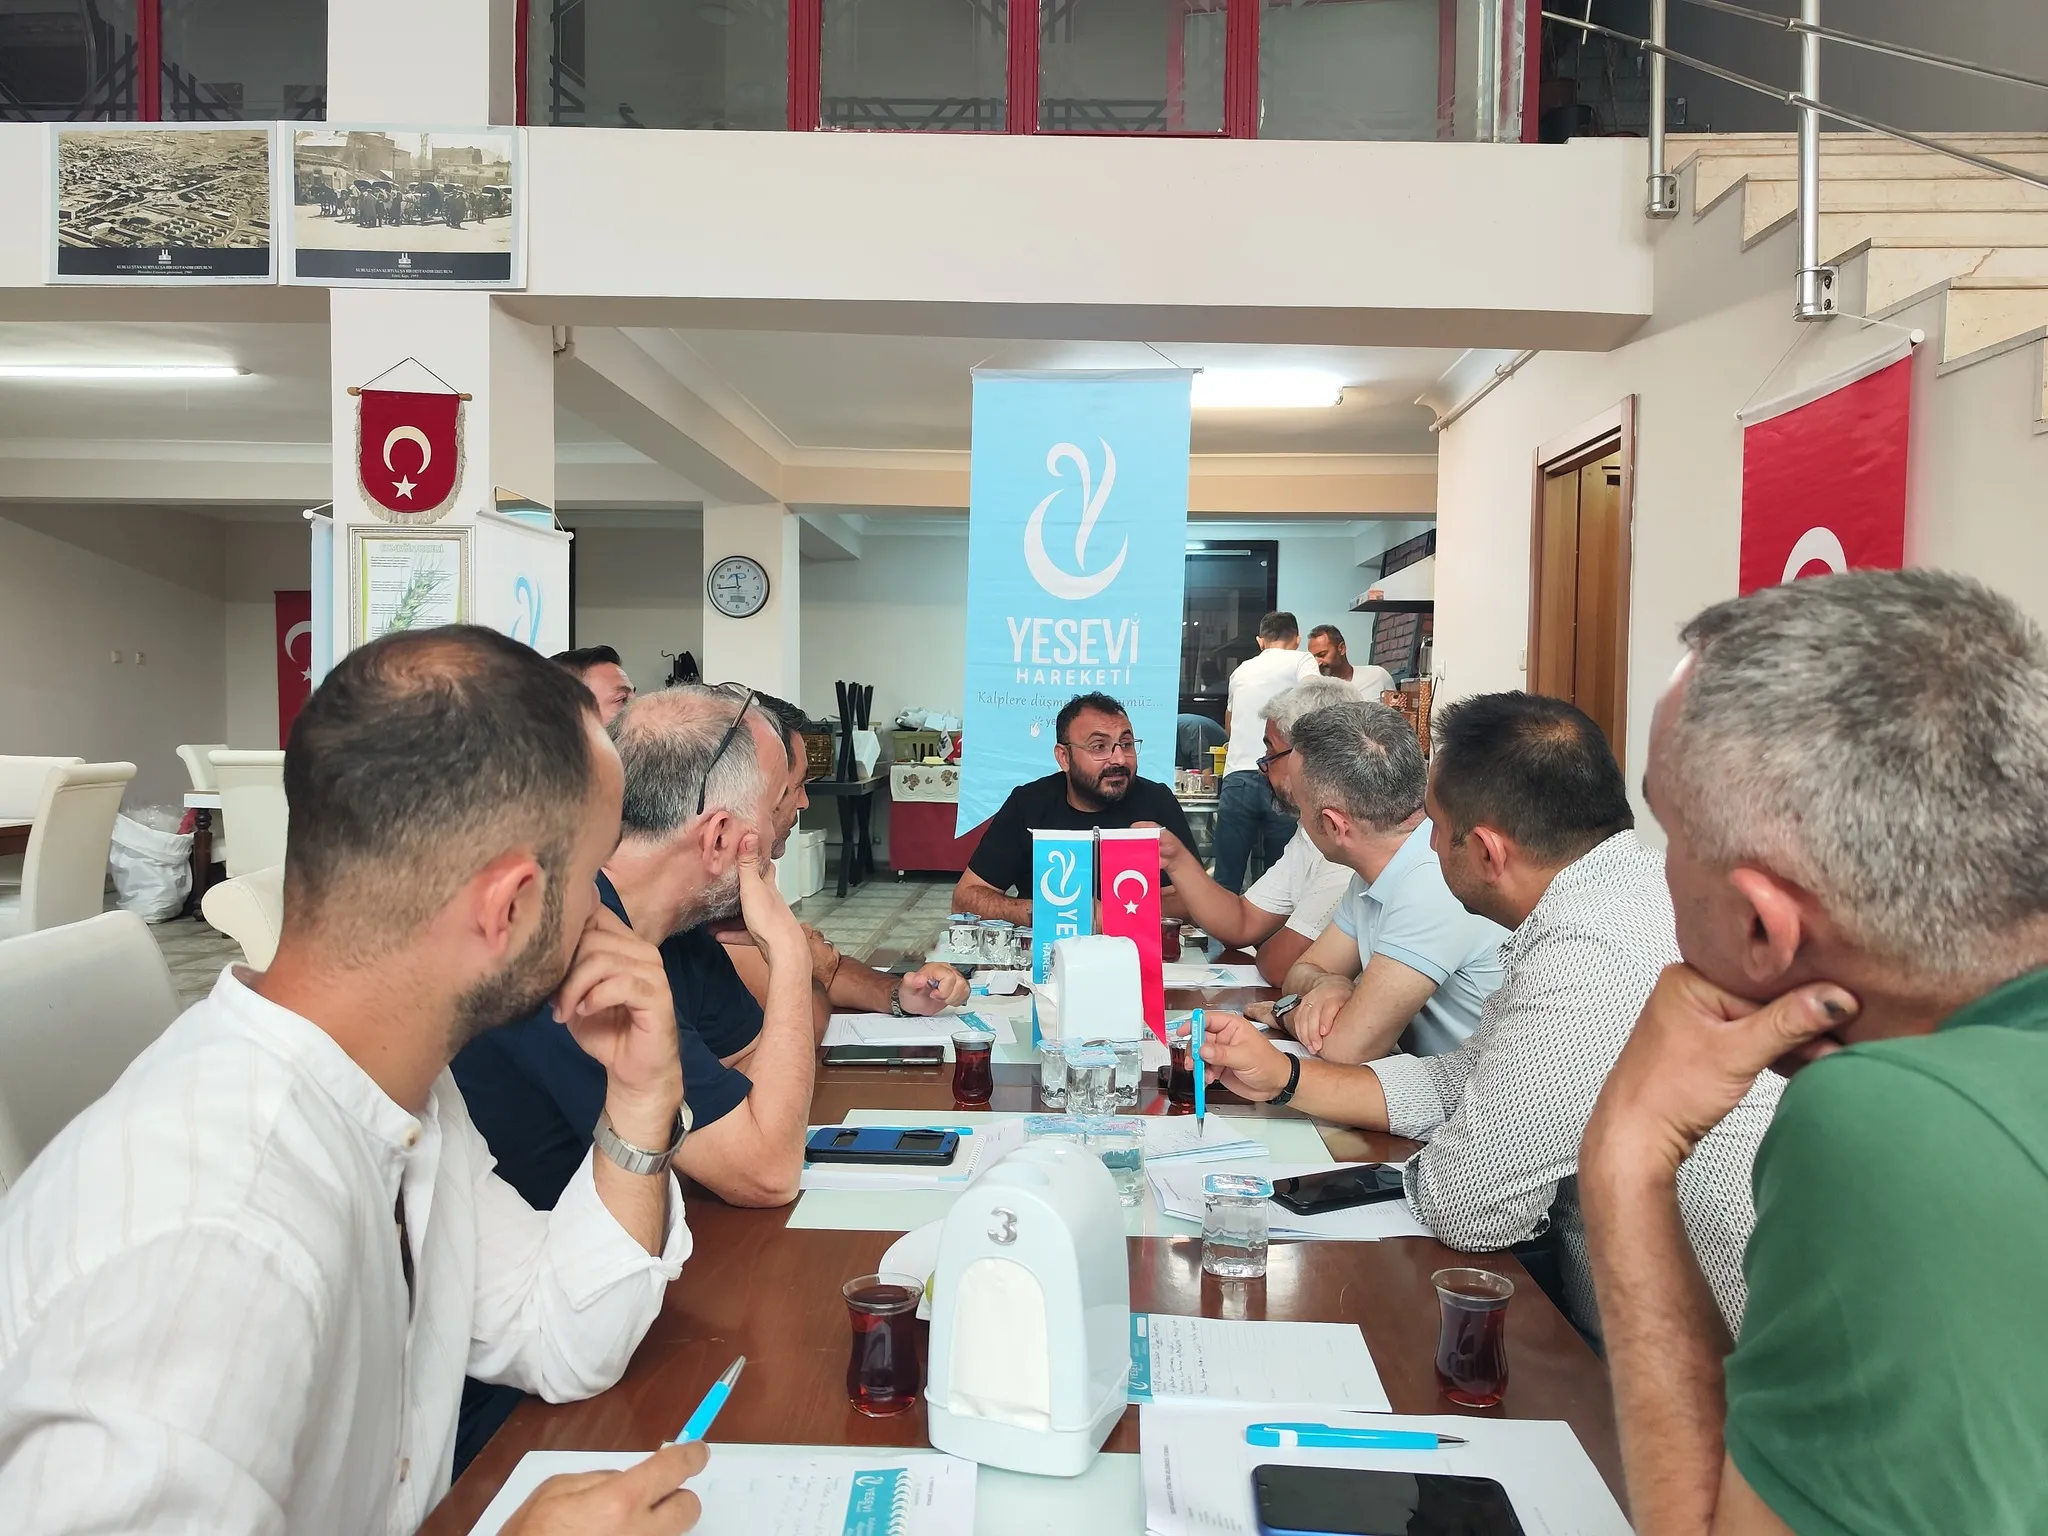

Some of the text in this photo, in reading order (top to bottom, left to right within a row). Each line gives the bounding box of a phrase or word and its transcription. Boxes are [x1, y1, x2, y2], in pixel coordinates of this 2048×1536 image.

[1006, 612, 1141, 665] YESEVİ
[1016, 665, 1130, 686] HAREKETİ
[977, 690, 1027, 709] Kalplere
[987, 1207, 1018, 1246] 3
